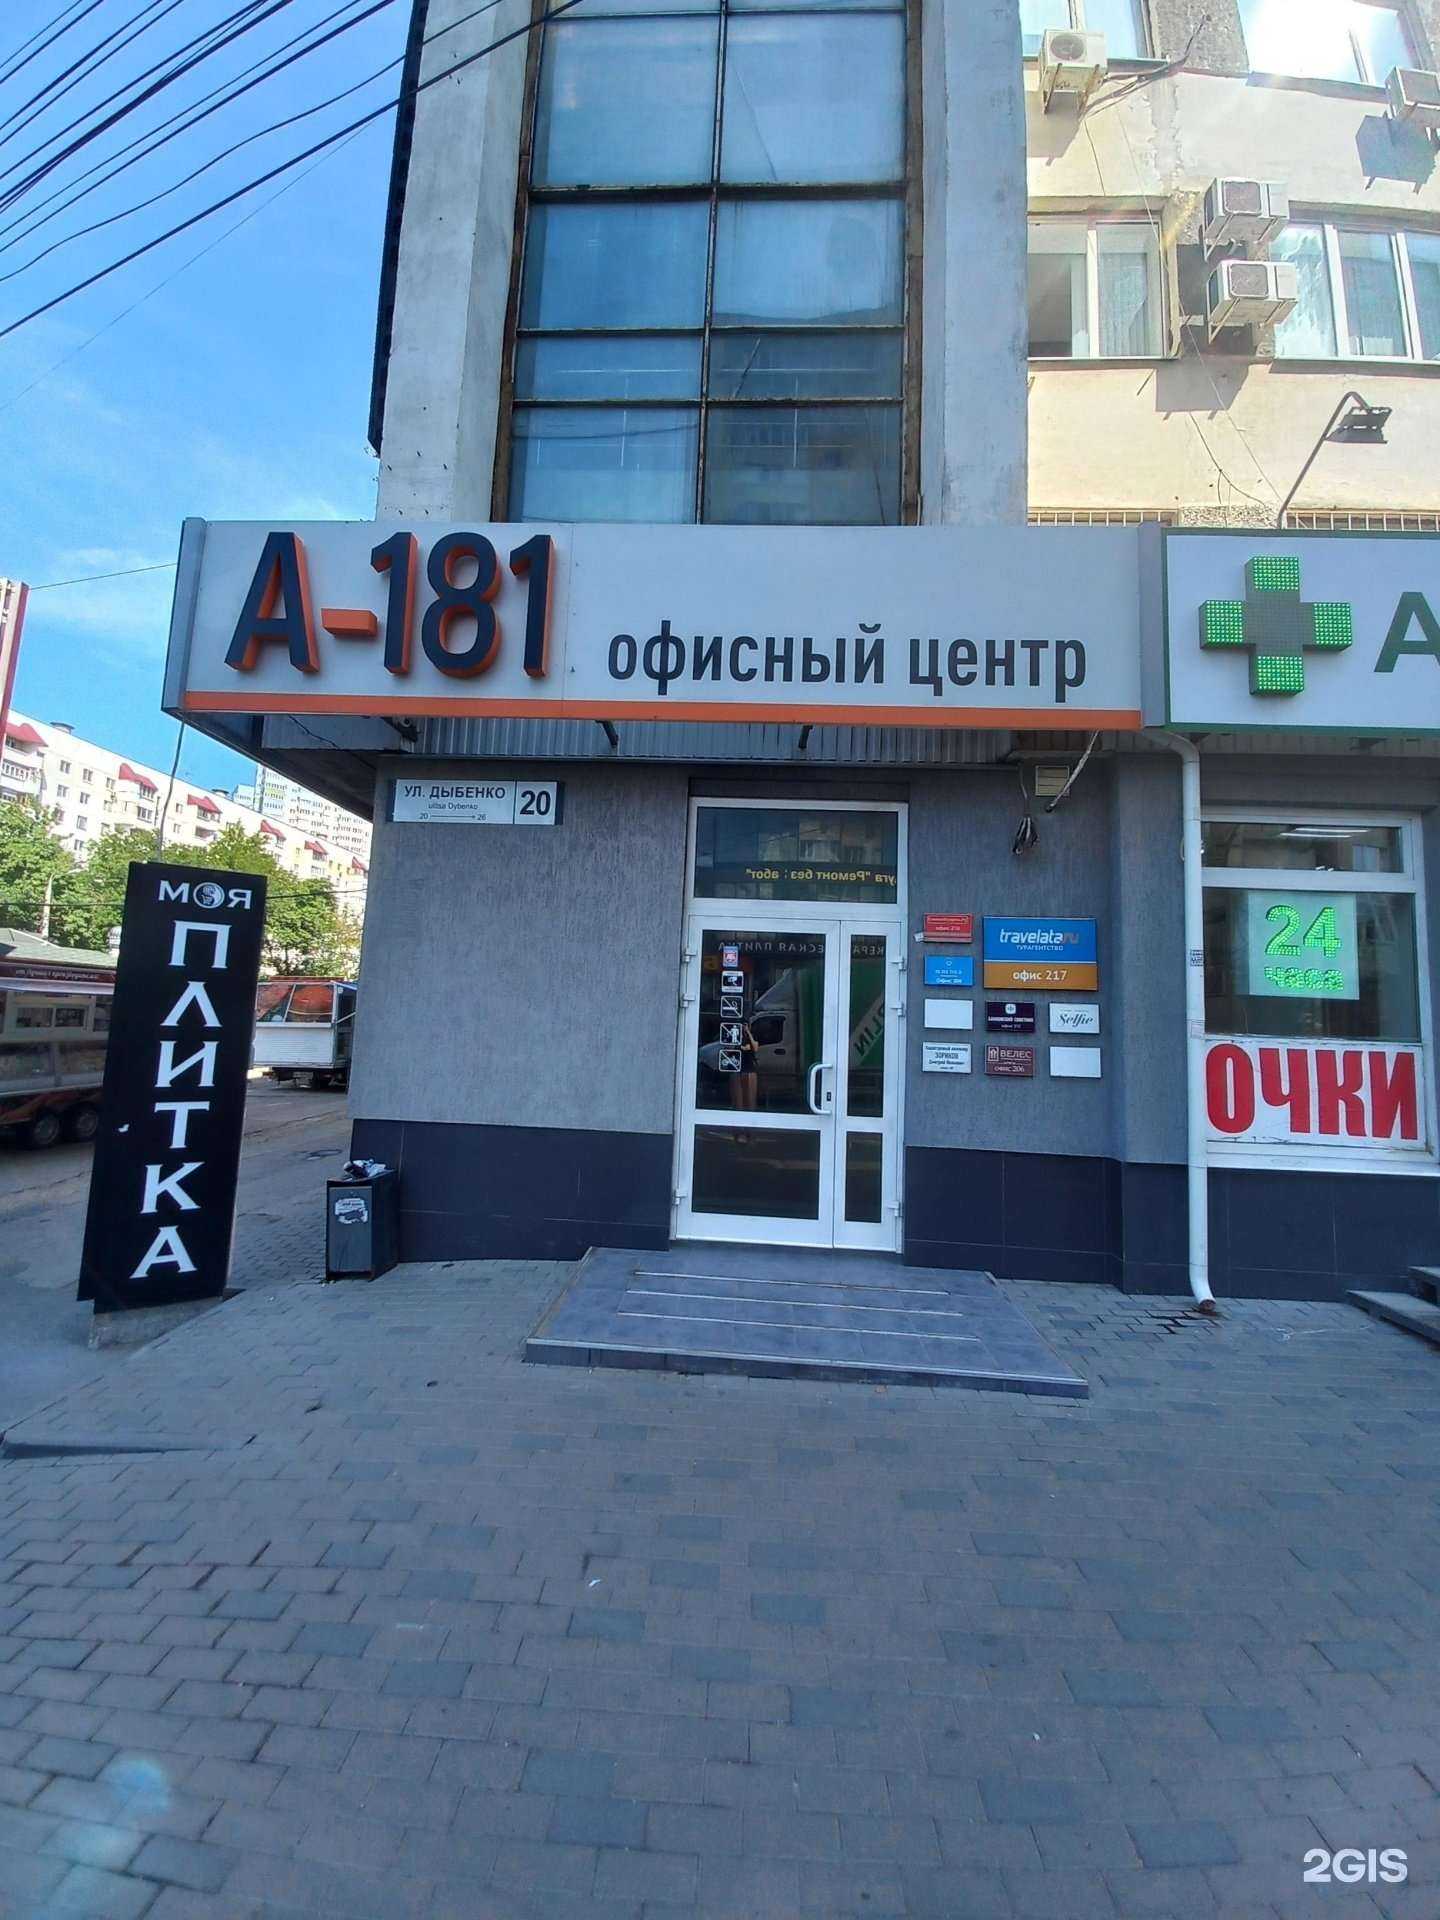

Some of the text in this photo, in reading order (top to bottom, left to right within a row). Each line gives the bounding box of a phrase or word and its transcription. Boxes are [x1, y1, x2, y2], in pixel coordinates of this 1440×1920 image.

[224, 531, 555, 679] А-181
[607, 619, 1087, 703] офисный центр
[404, 785, 506, 799] УЛ. ДЫБЕНКО
[519, 790, 551, 816] 20
[1264, 904, 1343, 958] 24
[1012, 969, 1068, 982] офис 217
[1264, 966, 1344, 992] часа
[1057, 1013, 1094, 1028] Selfie
[1000, 1049, 1033, 1059] ВЕЛЕС
[129, 920, 232, 1279] ПЛИТКА
[1205, 1043, 1419, 1141] ОЧКИ
